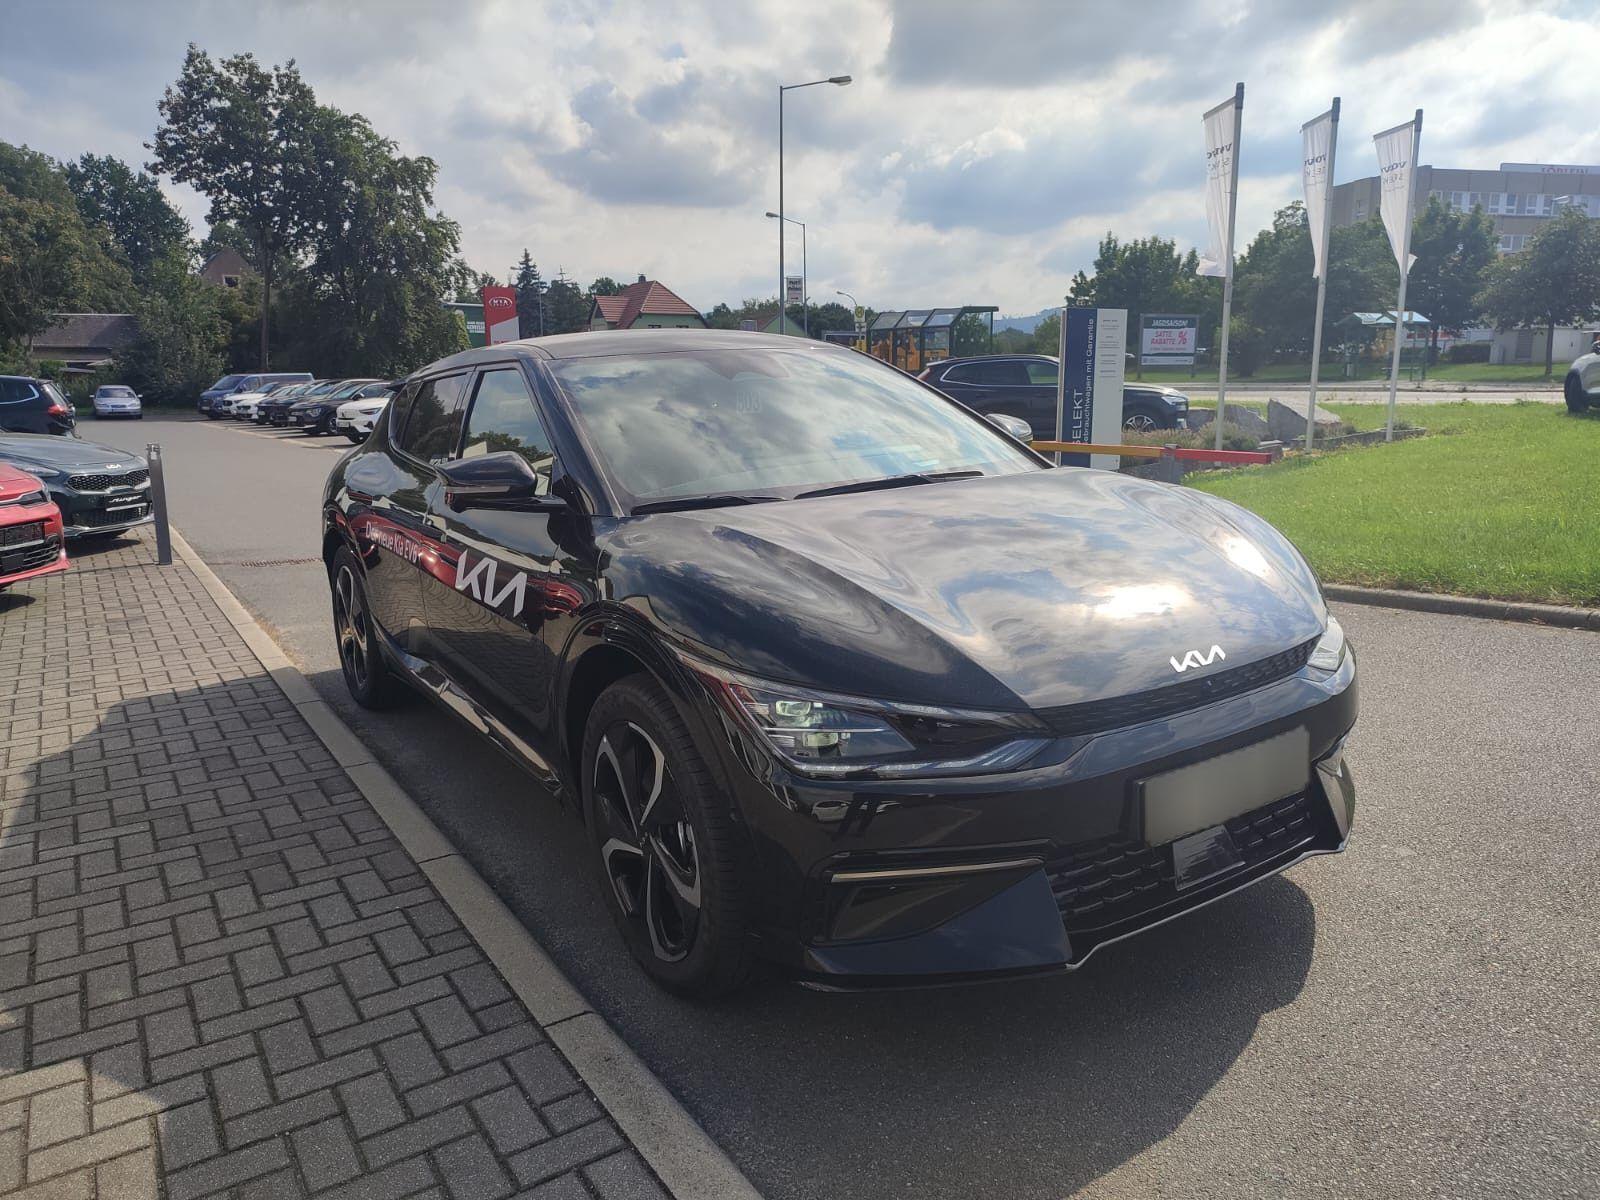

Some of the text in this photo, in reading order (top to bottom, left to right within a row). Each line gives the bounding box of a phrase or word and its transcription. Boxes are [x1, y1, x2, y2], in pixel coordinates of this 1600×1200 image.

[1082, 376, 1092, 444] ebrauchtwagen
[365, 521, 419, 564] Der neue Kia EV6
[455, 548, 527, 618] KIA
[1169, 644, 1226, 673] KIA
